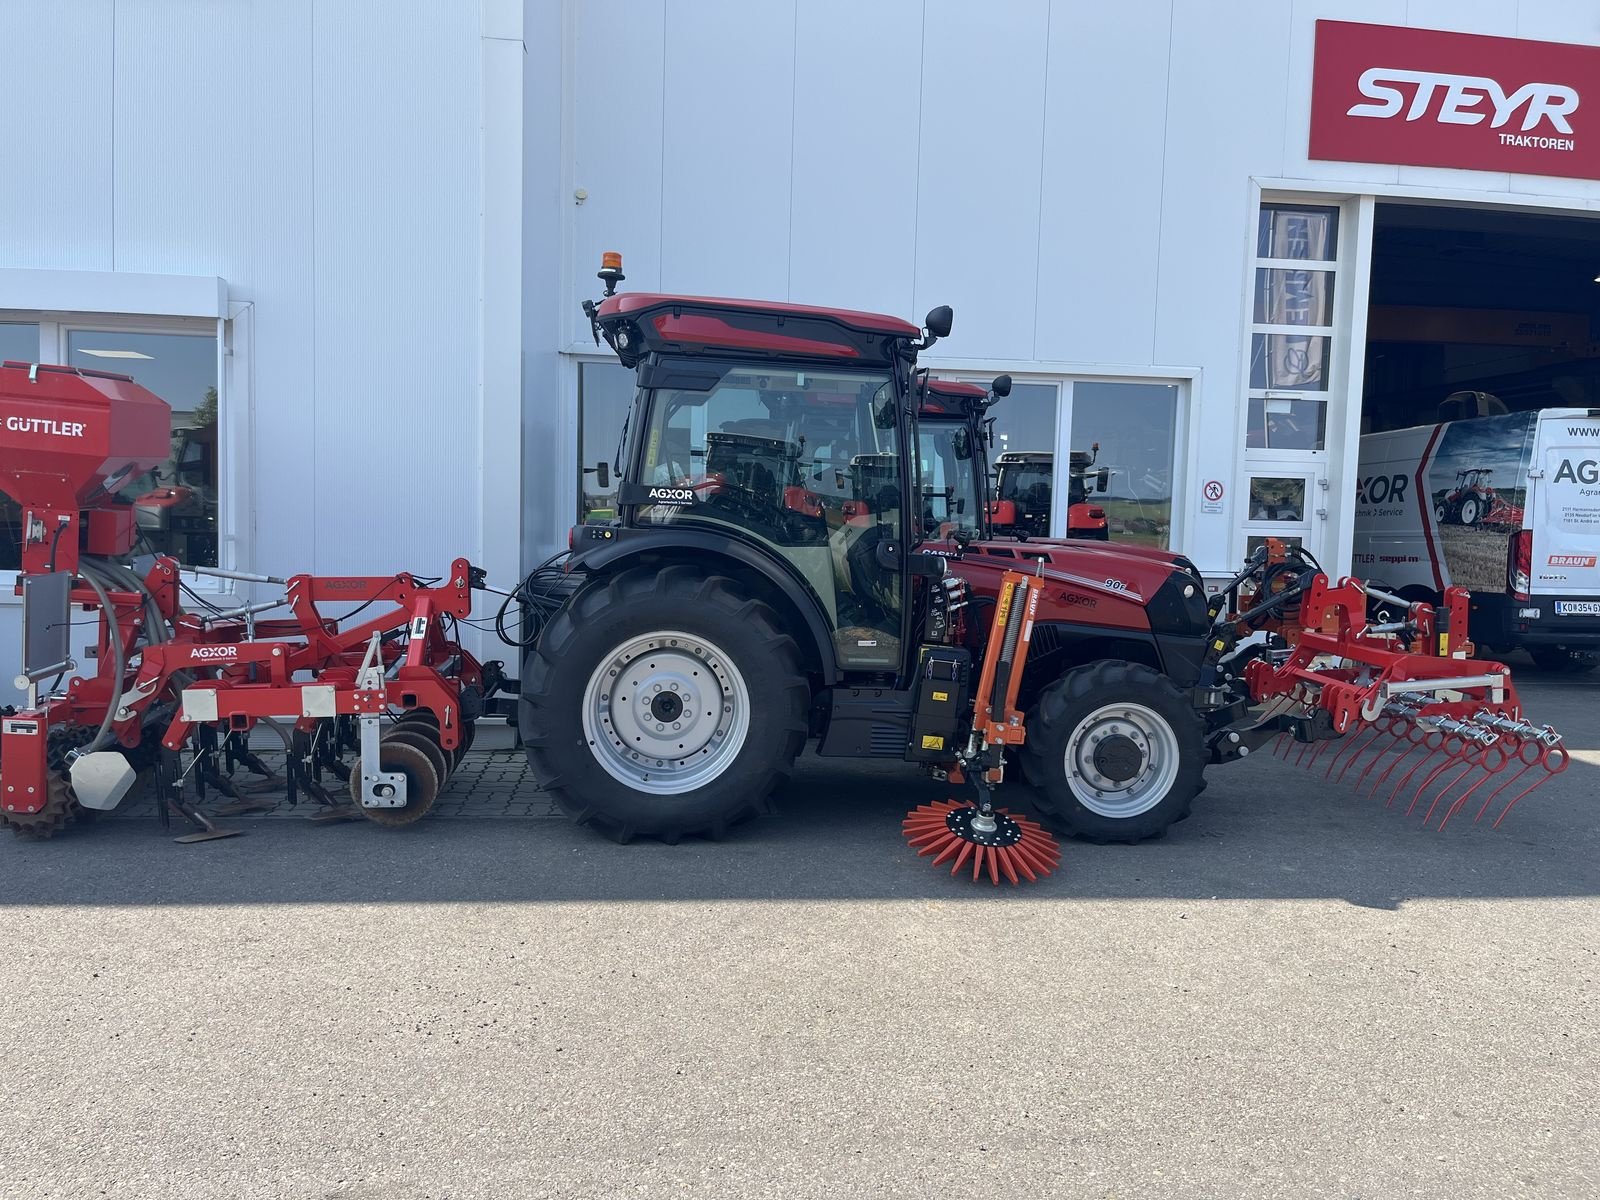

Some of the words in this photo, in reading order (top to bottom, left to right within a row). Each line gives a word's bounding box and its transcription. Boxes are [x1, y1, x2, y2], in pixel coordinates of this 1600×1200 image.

[1346, 67, 1580, 135] STEYR
[1498, 133, 1574, 151] TRAKTOREN
[1553, 459, 1600, 484] AG
[648, 488, 693, 500] AGXOR
[1379, 508, 1404, 516] Service
[1550, 556, 1590, 566] BRAUN
[1059, 591, 1097, 609] AGXOR
[190, 646, 237, 658] AGXOR
